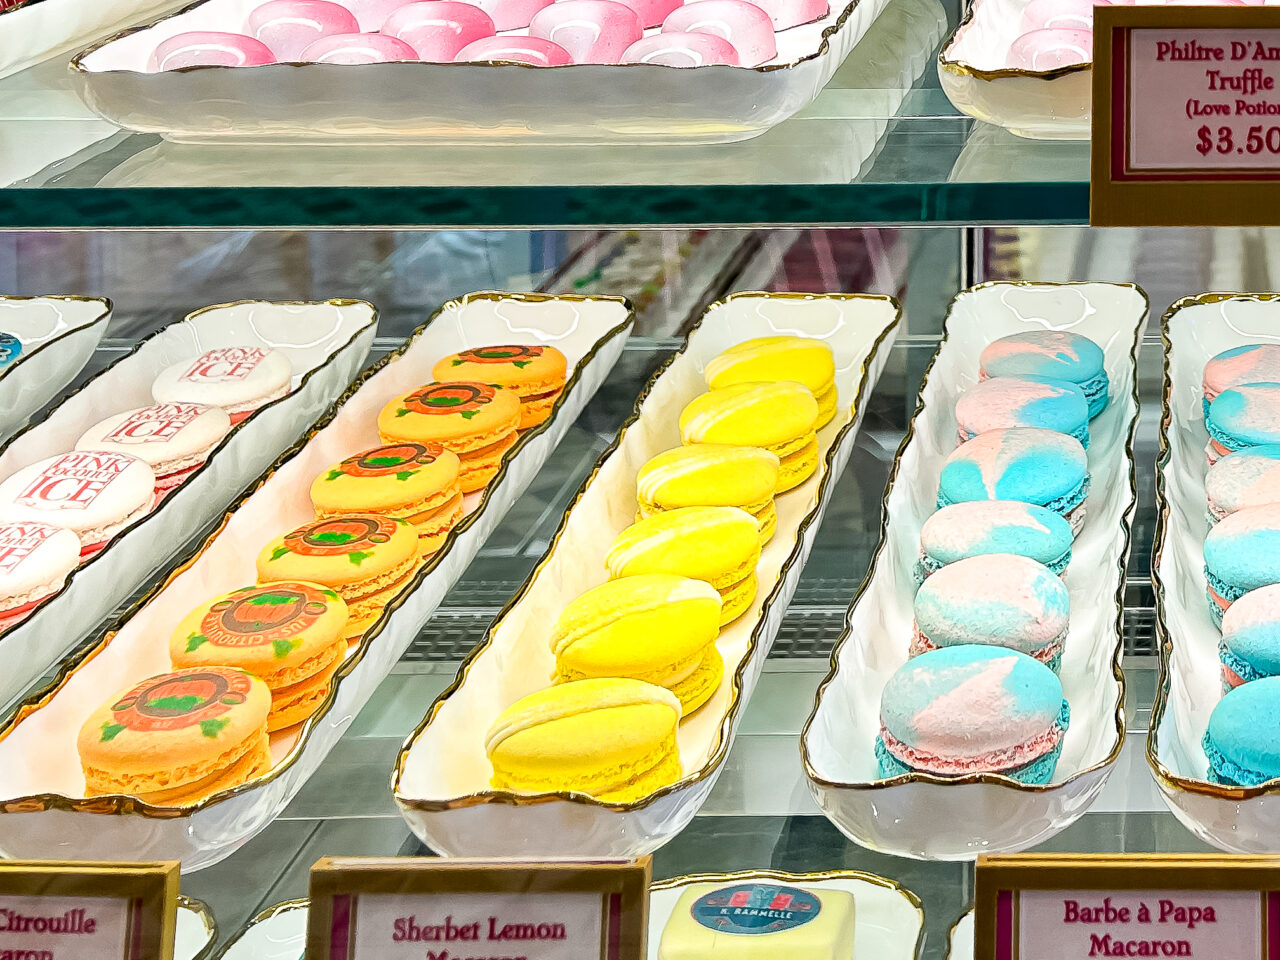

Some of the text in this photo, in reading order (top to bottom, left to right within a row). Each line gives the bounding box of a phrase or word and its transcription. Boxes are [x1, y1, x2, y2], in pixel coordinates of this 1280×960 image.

[1156, 40, 1225, 62] Philtre
[1206, 69, 1275, 95] Truffle
[1185, 98, 1231, 119] (Love
[111, 420, 186, 437] ICE
[52, 454, 124, 472] PINK
[24, 476, 106, 503] ICE
[734, 907, 793, 919] RAMMELLE
[1063, 897, 1217, 929] Barbe à Papa
[392, 915, 567, 942] Sherbet Lemon
[1088, 933, 1192, 957] Macaron
